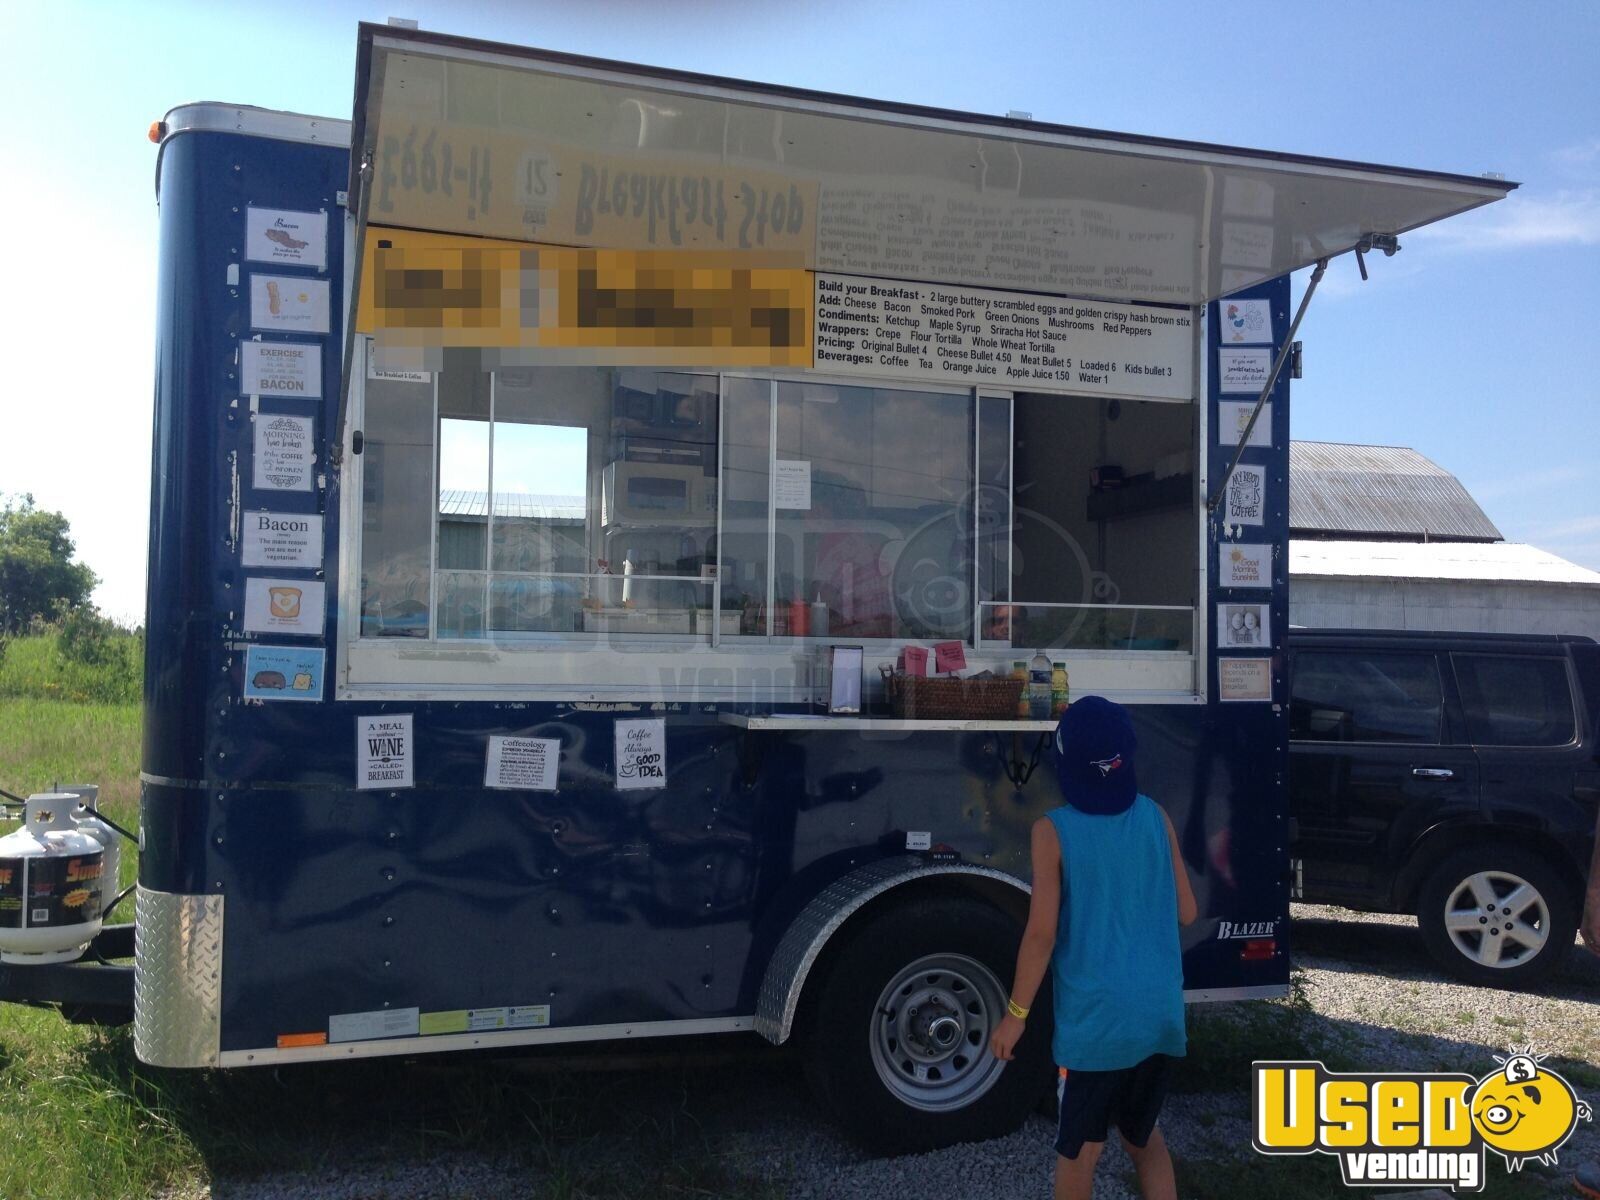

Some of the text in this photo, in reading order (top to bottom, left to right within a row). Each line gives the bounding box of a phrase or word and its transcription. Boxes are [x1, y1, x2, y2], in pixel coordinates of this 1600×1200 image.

[819, 280, 842, 292] Build
[846, 284, 866, 295] your
[870, 286, 918, 300] Breakfast
[930, 292, 936, 302] 2
[938, 292, 958, 305] large
[960, 294, 990, 309] buttery
[994, 299, 1035, 312] scrambled
[1037, 305, 1057, 316] eggs
[1059, 305, 1074, 316] and
[1076, 307, 1102, 319] golden
[1104, 310, 1128, 323] crispy
[1130, 312, 1148, 323] hash
[1150, 313, 1174, 326] brown
[1176, 315, 1190, 327] stix
[819, 294, 1152, 337] Add: Cheese Bacon Smoked Pork Green Onions Mushrooms Red Peppers
[819, 309, 1066, 341] Condiments: Ketchup Maple Syrup Sriracha Hot Sauce
[819, 322, 1055, 354] Wrappers: Crepe Flour Tortilla Whole Wheat Tortilla
[260, 349, 304, 358] EXERCISE
[818, 336, 1172, 376] Pricing: Original Bullet 4 Cheese Bullet 4.50 Meat Bullet 5 Loaded 6 Kids bullet 3
[818, 350, 872, 364] Beverages:
[880, 355, 908, 367] Coffee
[919, 359, 932, 369] Tea
[943, 360, 972, 374] Orange
[976, 363, 996, 374] Juice
[1006, 366, 1029, 379] Apple
[1032, 369, 1052, 380] Juice
[1079, 373, 1102, 383] Water
[1104, 374, 1108, 384] 1
[260, 380, 304, 391] BACON
[263, 430, 305, 439] MORNING
[258, 516, 308, 532] Bacon
[368, 723, 404, 731] A MEAL
[627, 729, 652, 741] Coffee
[636, 753, 661, 765] GOOD
[368, 770, 404, 781] BREAKFAST
[638, 766, 663, 778] IDEA
[1217, 922, 1274, 939] BLAZER
